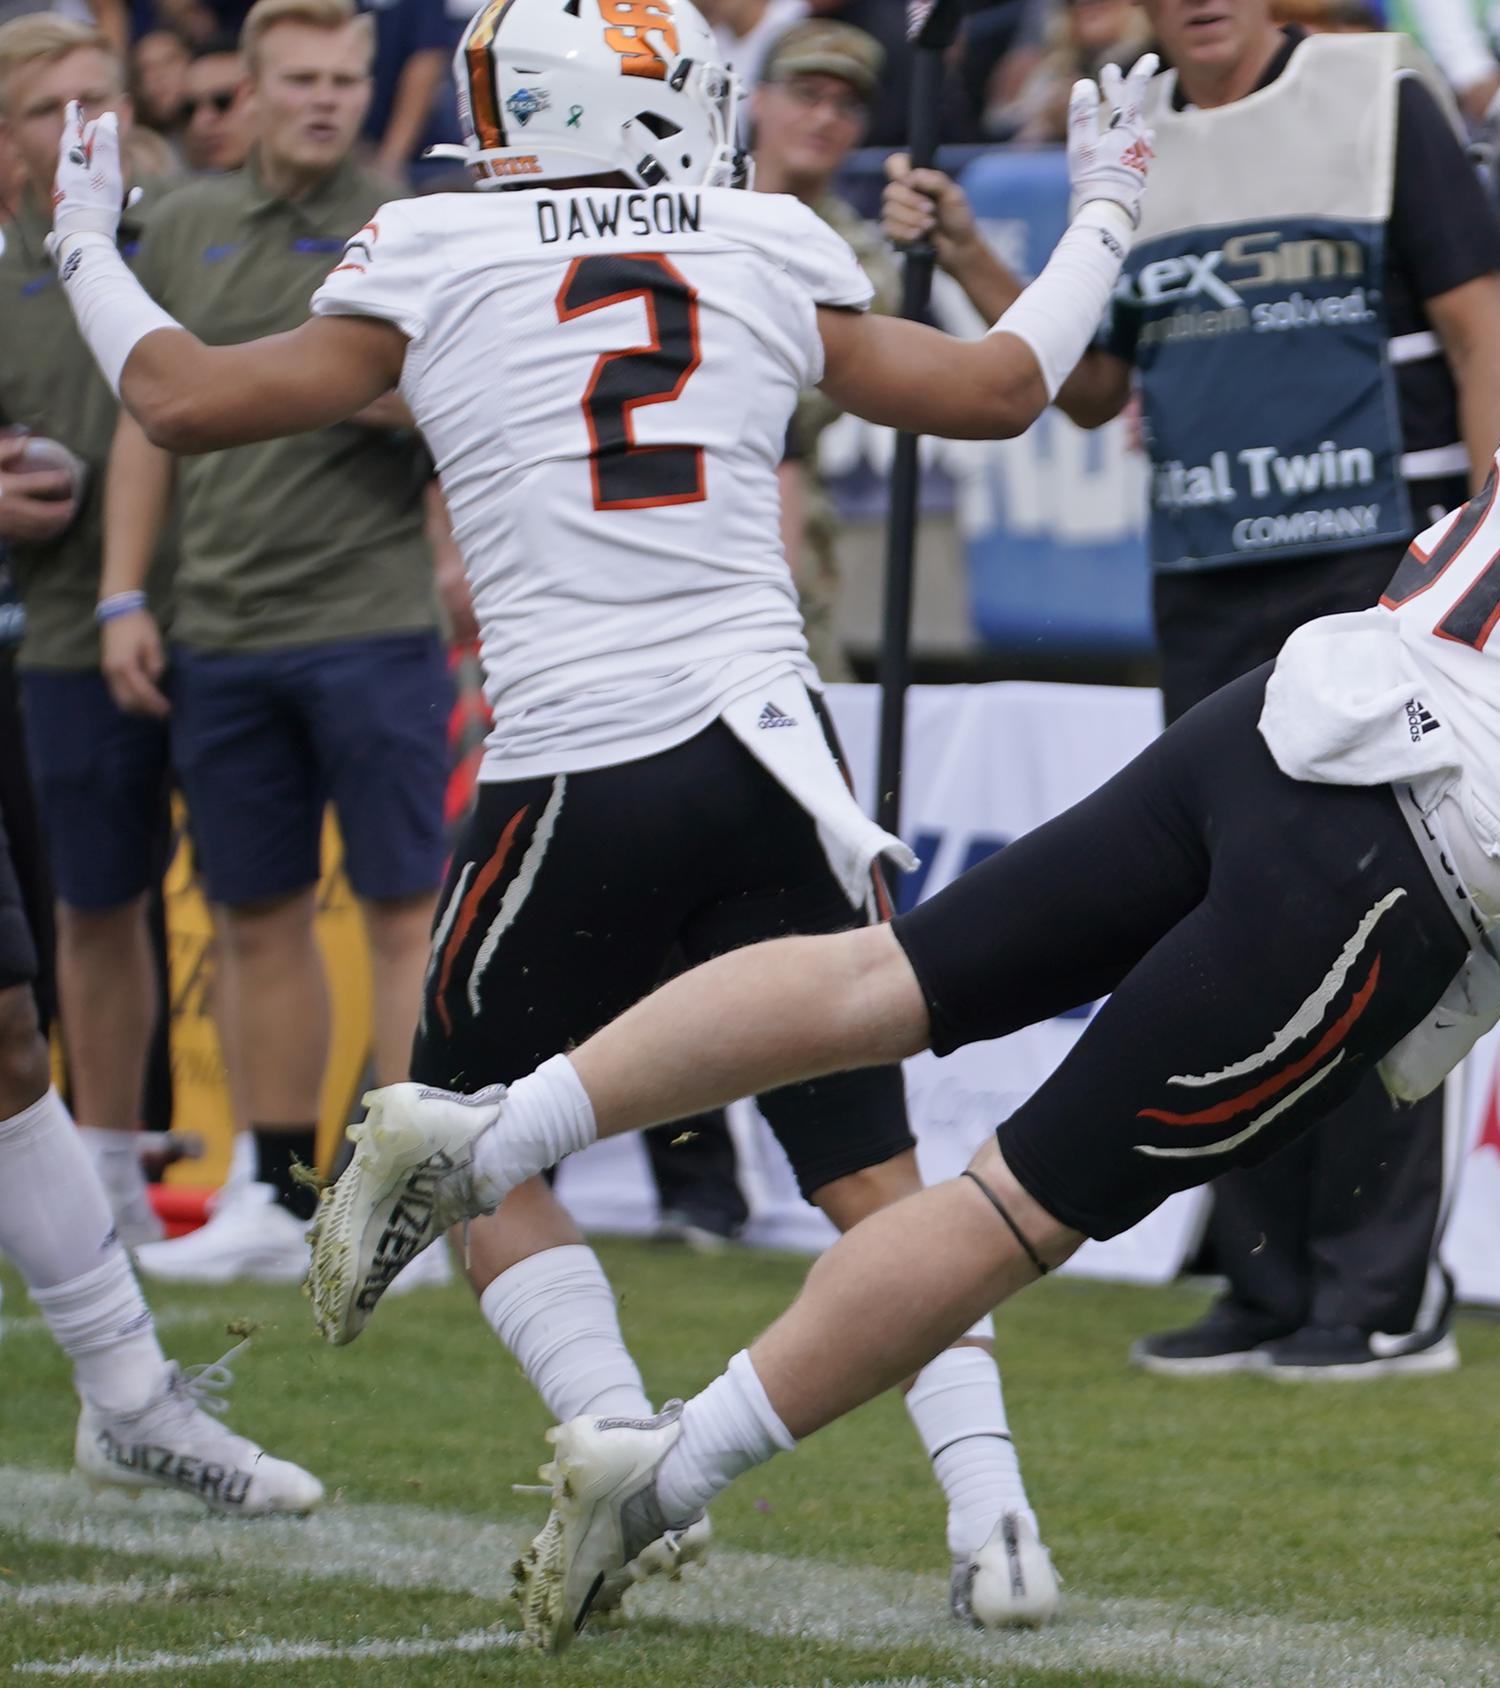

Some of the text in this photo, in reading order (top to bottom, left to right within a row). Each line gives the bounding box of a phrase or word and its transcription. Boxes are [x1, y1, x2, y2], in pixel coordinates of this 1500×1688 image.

[537, 193, 702, 244] DAWSON
[1112, 231, 1362, 308] exSim
[555, 252, 708, 511] 2
[1238, 440, 1374, 497] Twin
[1232, 503, 1380, 550] COMPANY
